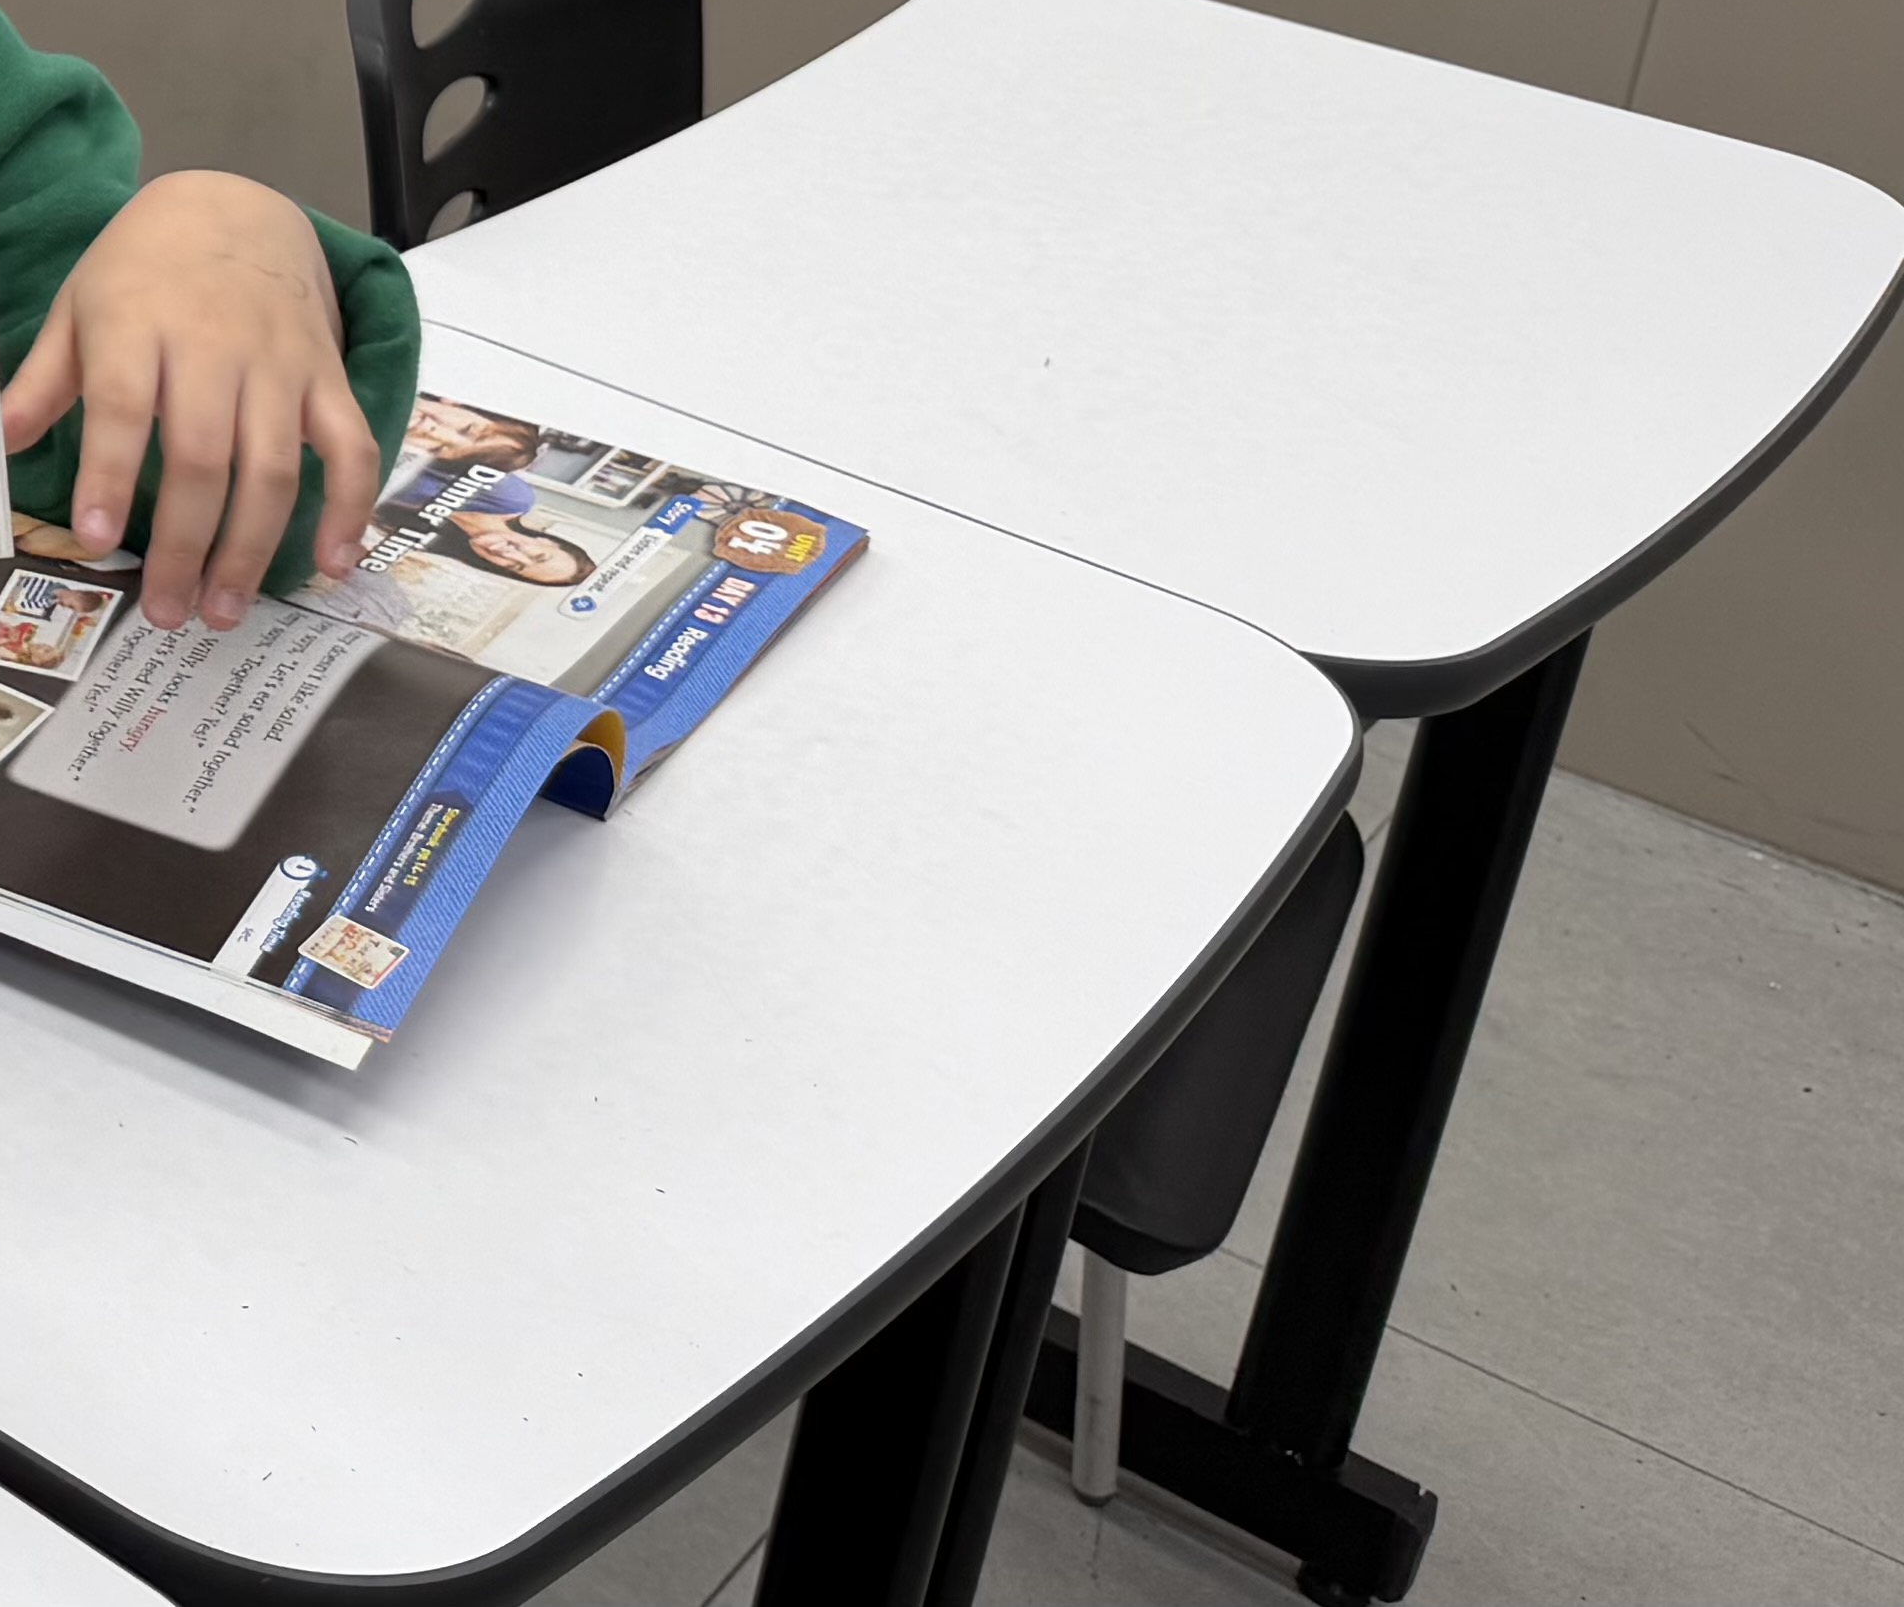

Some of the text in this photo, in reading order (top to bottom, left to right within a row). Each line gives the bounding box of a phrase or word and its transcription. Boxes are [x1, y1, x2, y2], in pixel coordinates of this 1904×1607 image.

[359, 463, 507, 576] Dinner Time
[656, 500, 694, 527] Story
[728, 520, 789, 557] 04
[783, 534, 818, 563] UNIT
[644, 575, 755, 683] DAY 13 Reading
[134, 654, 166, 687] feed
[310, 643, 349, 682] doesn't
[108, 685, 146, 721] Willy
[119, 636, 220, 755] Willy, looks hungry.
[212, 654, 267, 716] "Together?
[254, 689, 272, 714] eat
[292, 680, 320, 708] like
[191, 716, 222, 749] Yes!"
[222, 711, 255, 750] salad
[263, 705, 296, 743] salad.
[67, 717, 120, 783] together."
[182, 747, 234, 815] together."
[273, 889, 313, 930] Reading
